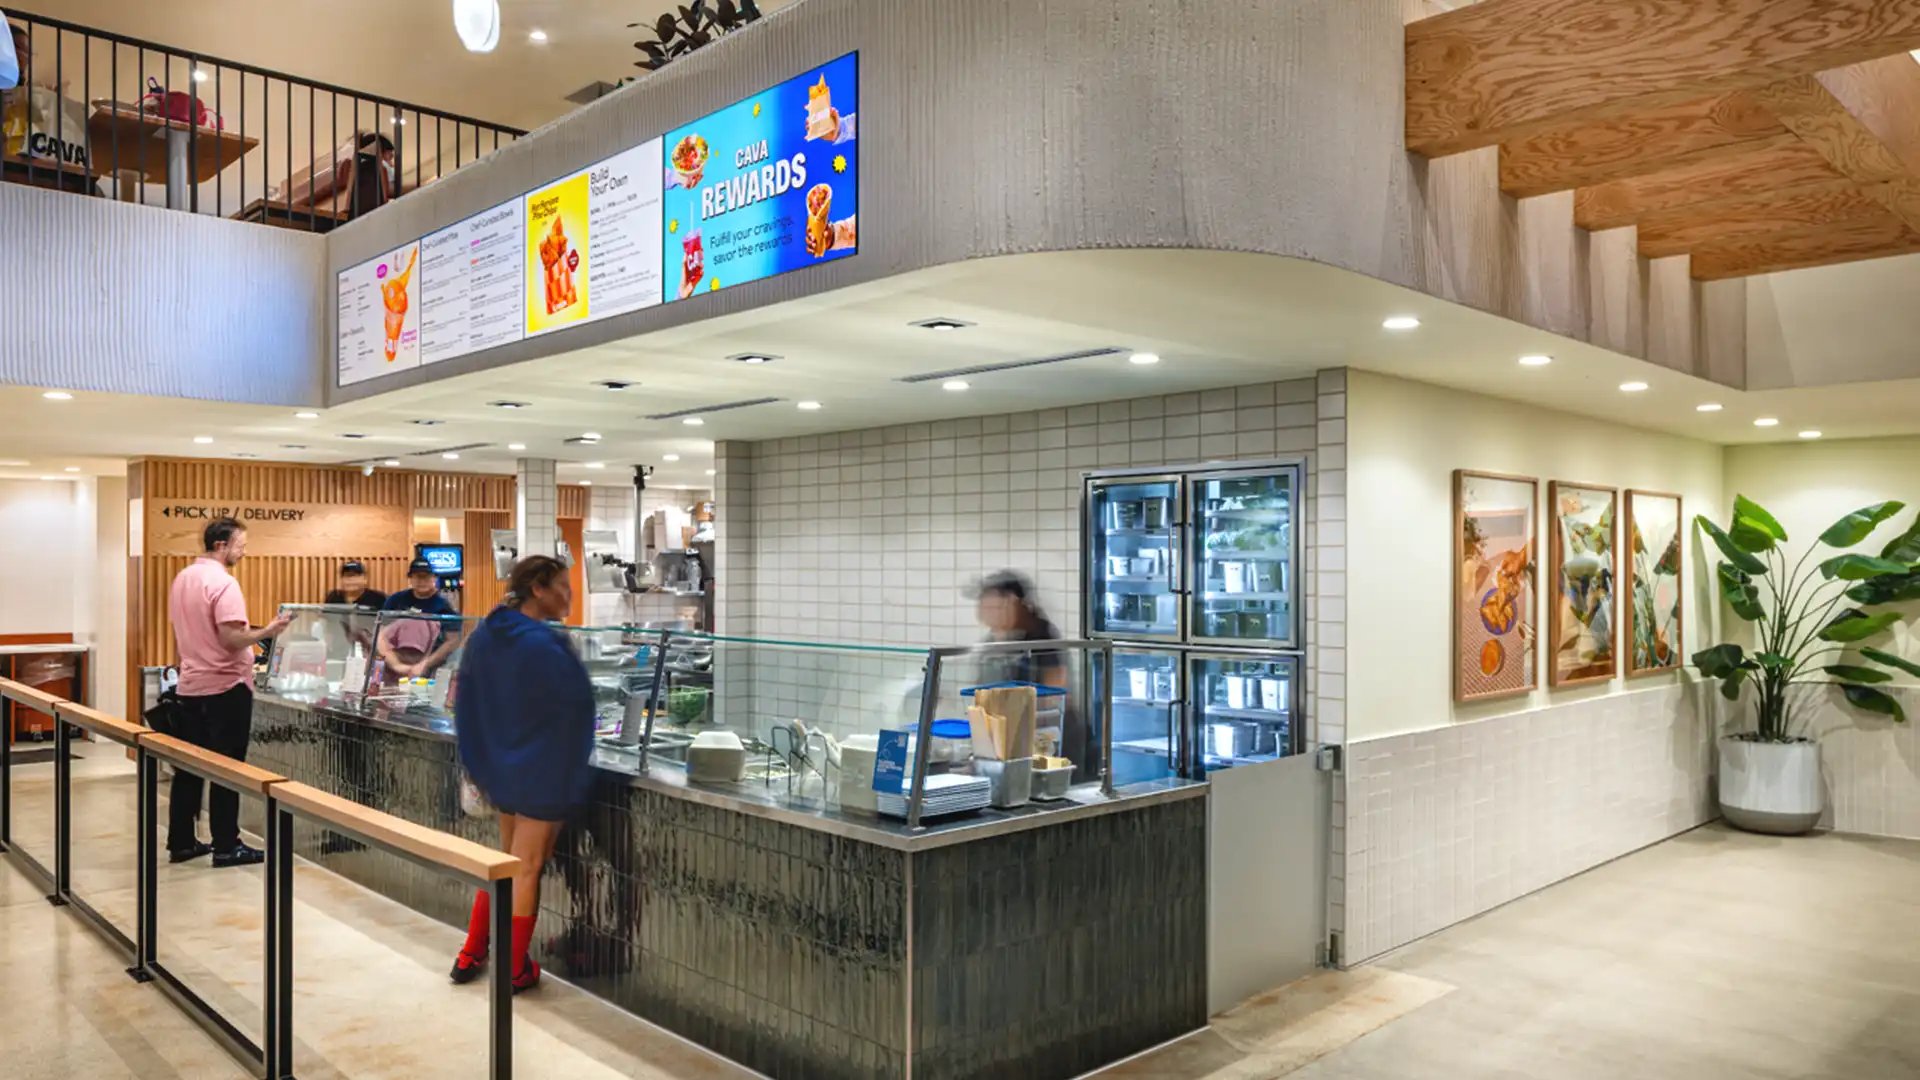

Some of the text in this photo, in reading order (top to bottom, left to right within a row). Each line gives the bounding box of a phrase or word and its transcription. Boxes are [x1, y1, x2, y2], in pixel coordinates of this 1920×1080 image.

[31, 132, 88, 166] CAVA
[735, 139, 768, 169] CAVA
[590, 167, 609, 185] Build
[590, 173, 628, 198] Your Own
[702, 152, 806, 221] REWARDS
[710, 231, 731, 249] Fulfill
[732, 227, 752, 246] your
[713, 249, 736, 266] savor
[737, 243, 754, 259] the
[174, 506, 207, 519] PICK
[211, 507, 230, 518] UP
[244, 508, 305, 521] DELIVERY
